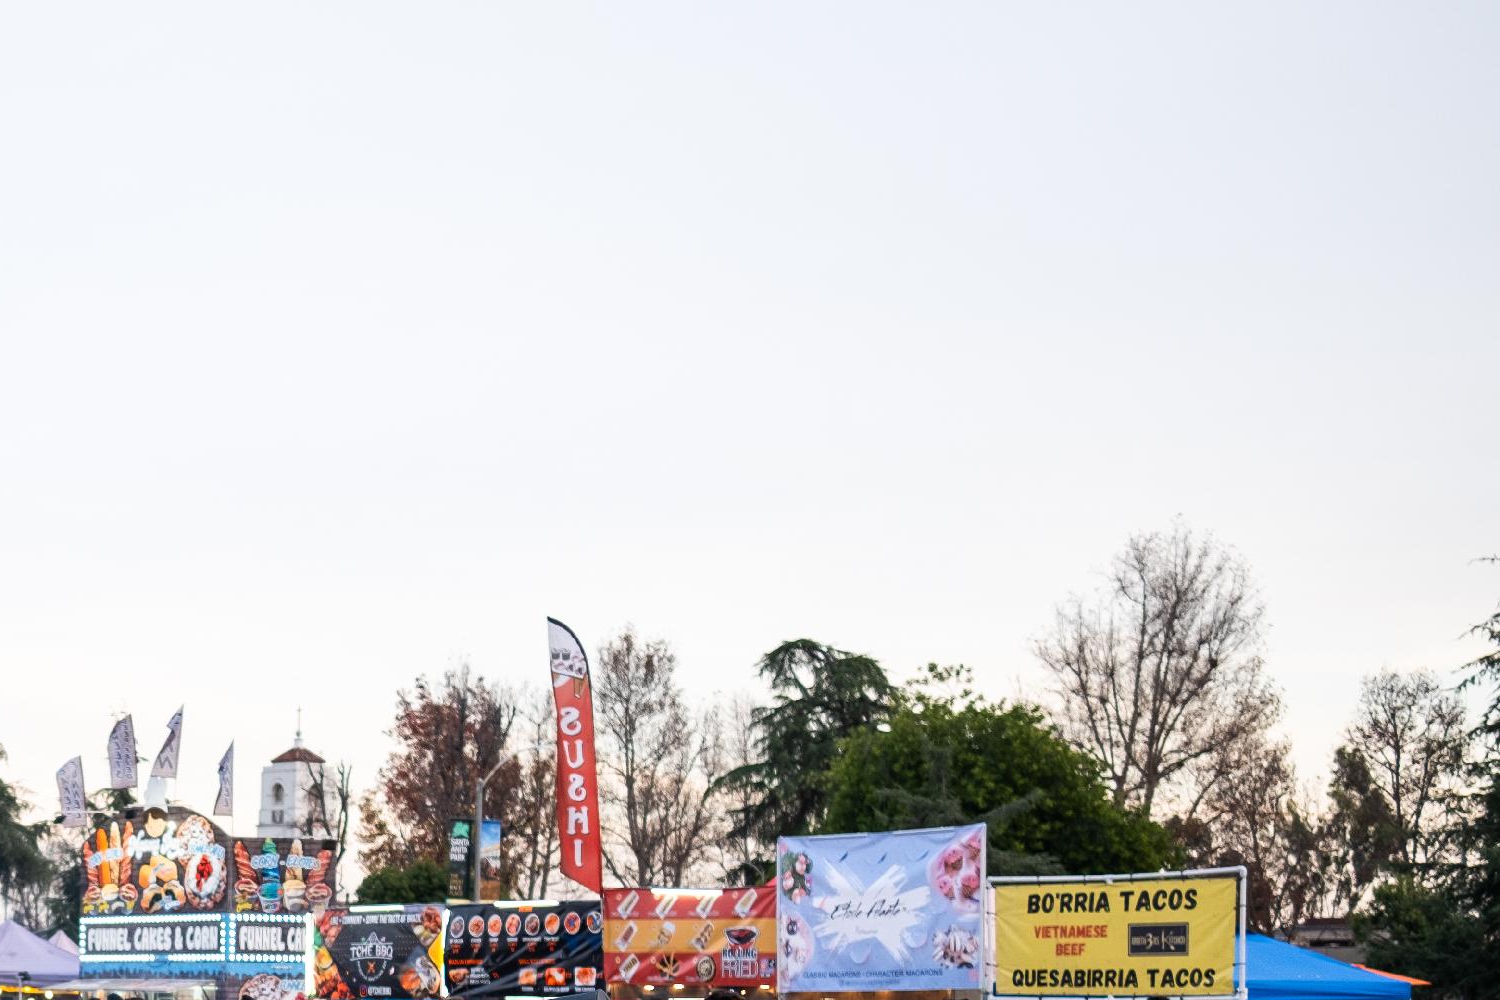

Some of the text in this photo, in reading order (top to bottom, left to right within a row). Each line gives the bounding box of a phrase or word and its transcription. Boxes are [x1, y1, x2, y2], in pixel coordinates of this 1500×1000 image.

[450, 838, 469, 846] SANTA
[450, 846, 467, 854] ANITA
[449, 853, 465, 862] PARK
[1027, 888, 1198, 914] BO'RRIA TACOS
[88, 926, 219, 951] FUNNEL CAKES & CORN
[239, 926, 285, 951] FUNNEL
[1034, 924, 1108, 939] VIETNAMESE
[375, 944, 394, 958] BBQ
[722, 948, 757, 959] ROLLING
[1055, 943, 1086, 957] BEEF
[721, 959, 759, 977] FRIED
[803, 971, 827, 979] CLASSIC
[828, 970, 861, 978] MACARONS
[905, 968, 943, 976] MACARONS
[1012, 968, 1216, 988] QUESABIRRIA TACOS
